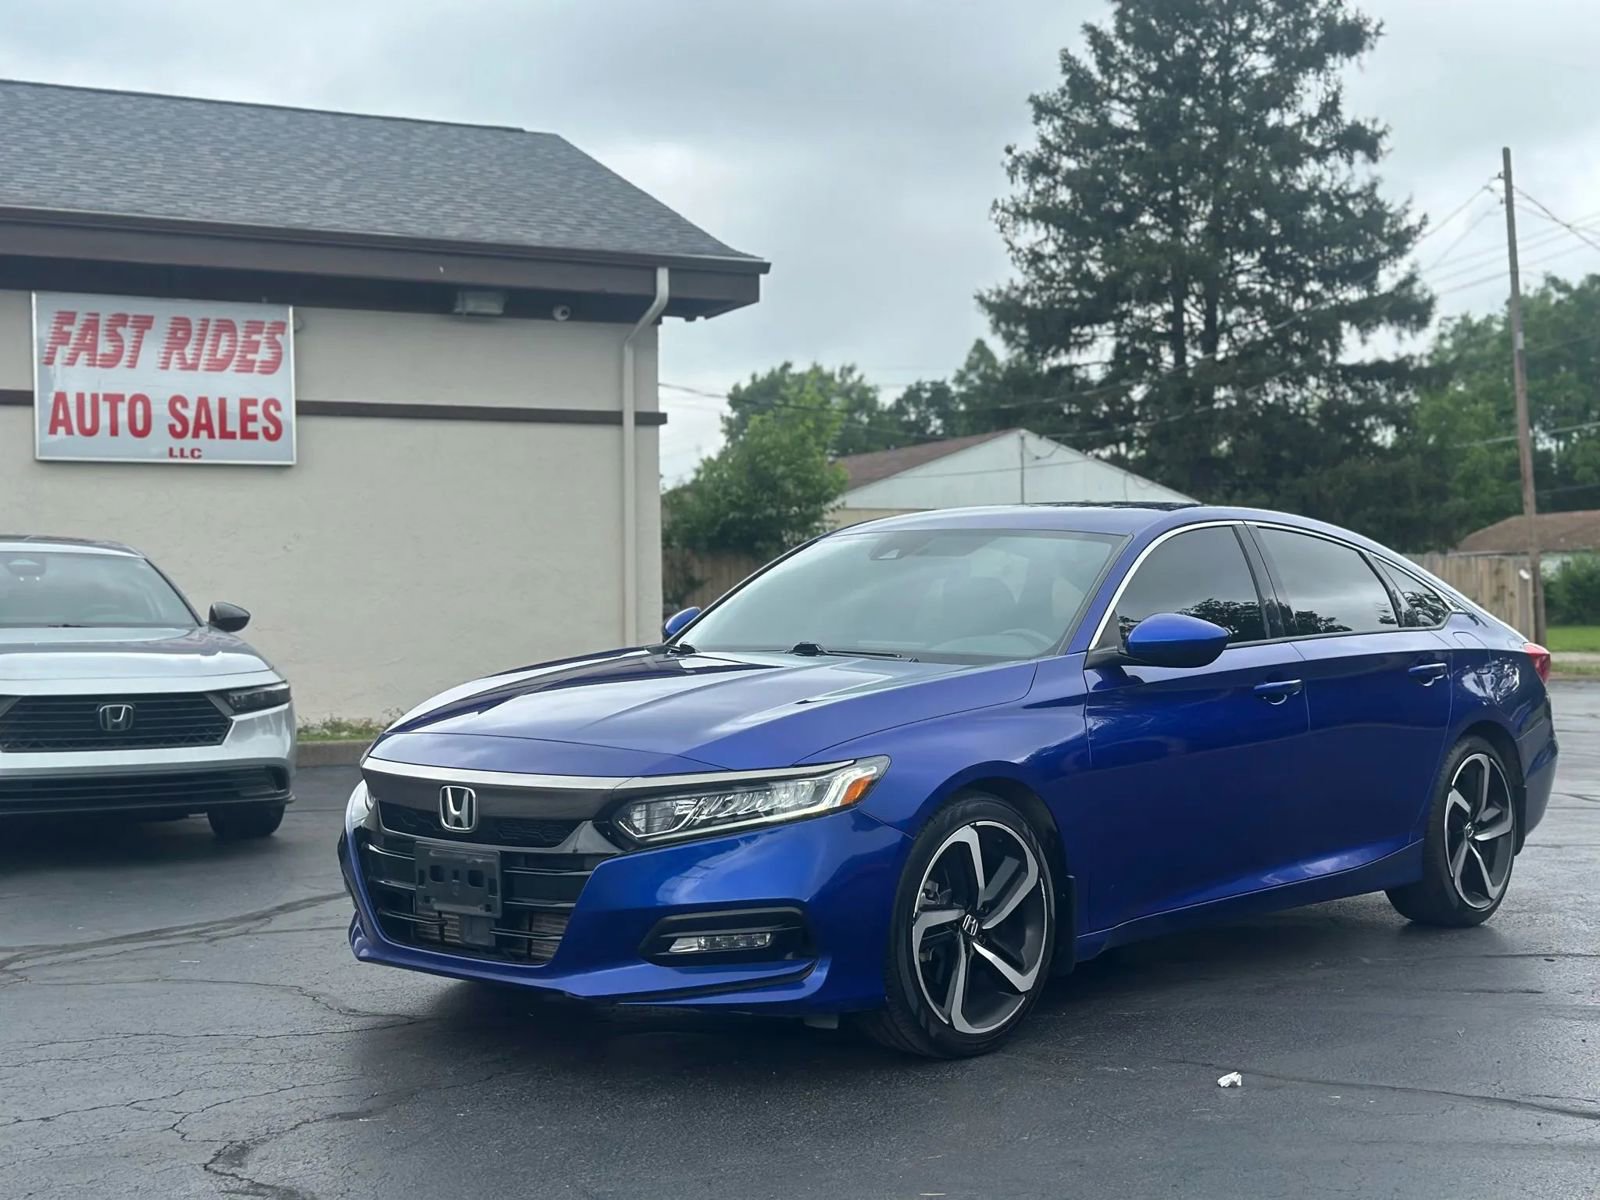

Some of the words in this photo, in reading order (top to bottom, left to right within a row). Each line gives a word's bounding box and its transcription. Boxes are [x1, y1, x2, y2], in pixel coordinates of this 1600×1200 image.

[42, 310, 154, 369] FAST
[157, 316, 286, 375] RIDES
[48, 391, 152, 438] AUTO
[168, 394, 283, 442] SALES
[168, 447, 202, 459] LLC
